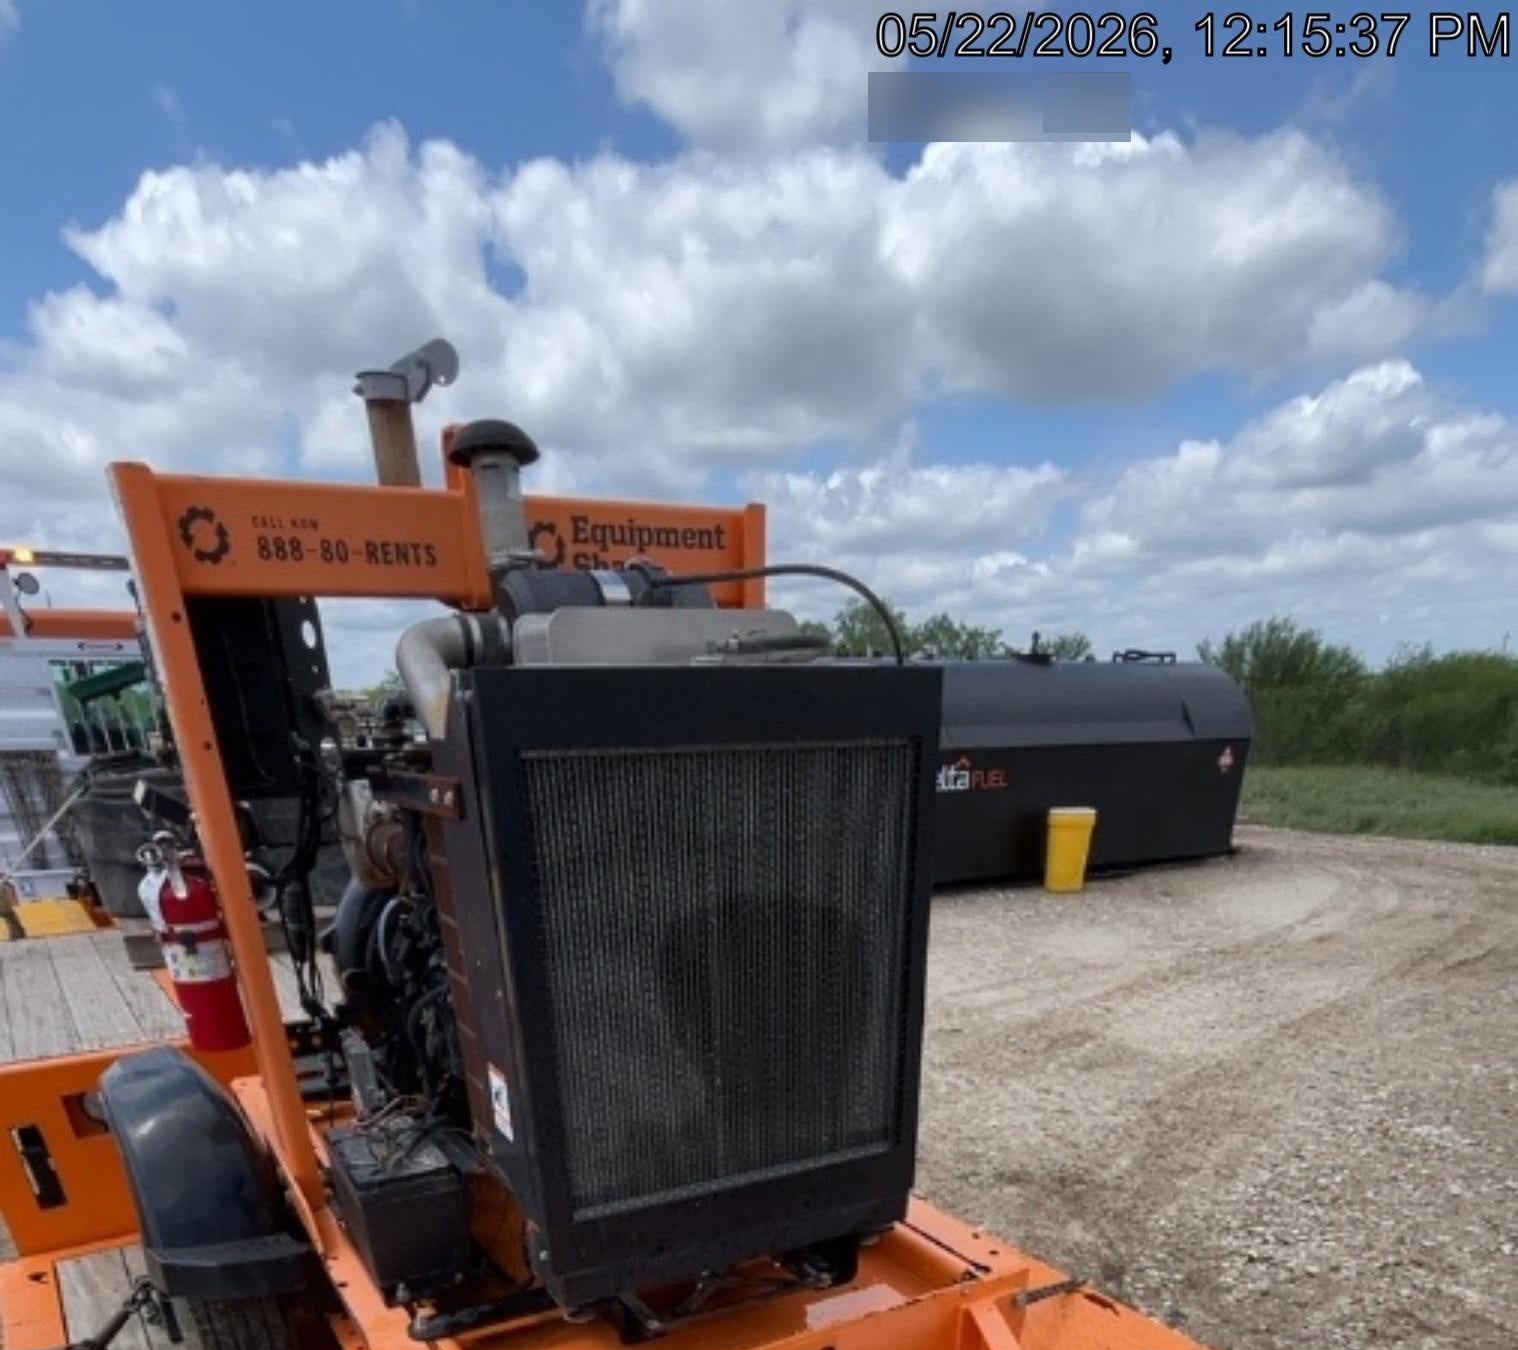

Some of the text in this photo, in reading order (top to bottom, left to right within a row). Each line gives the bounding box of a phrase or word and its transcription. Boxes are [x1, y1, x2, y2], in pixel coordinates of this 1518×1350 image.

[251, 515, 319, 531] CALL NOW
[570, 515, 726, 552] Equipment
[257, 535, 438, 567] 888-80-RENTS
[971, 769, 1008, 791] FUEL
